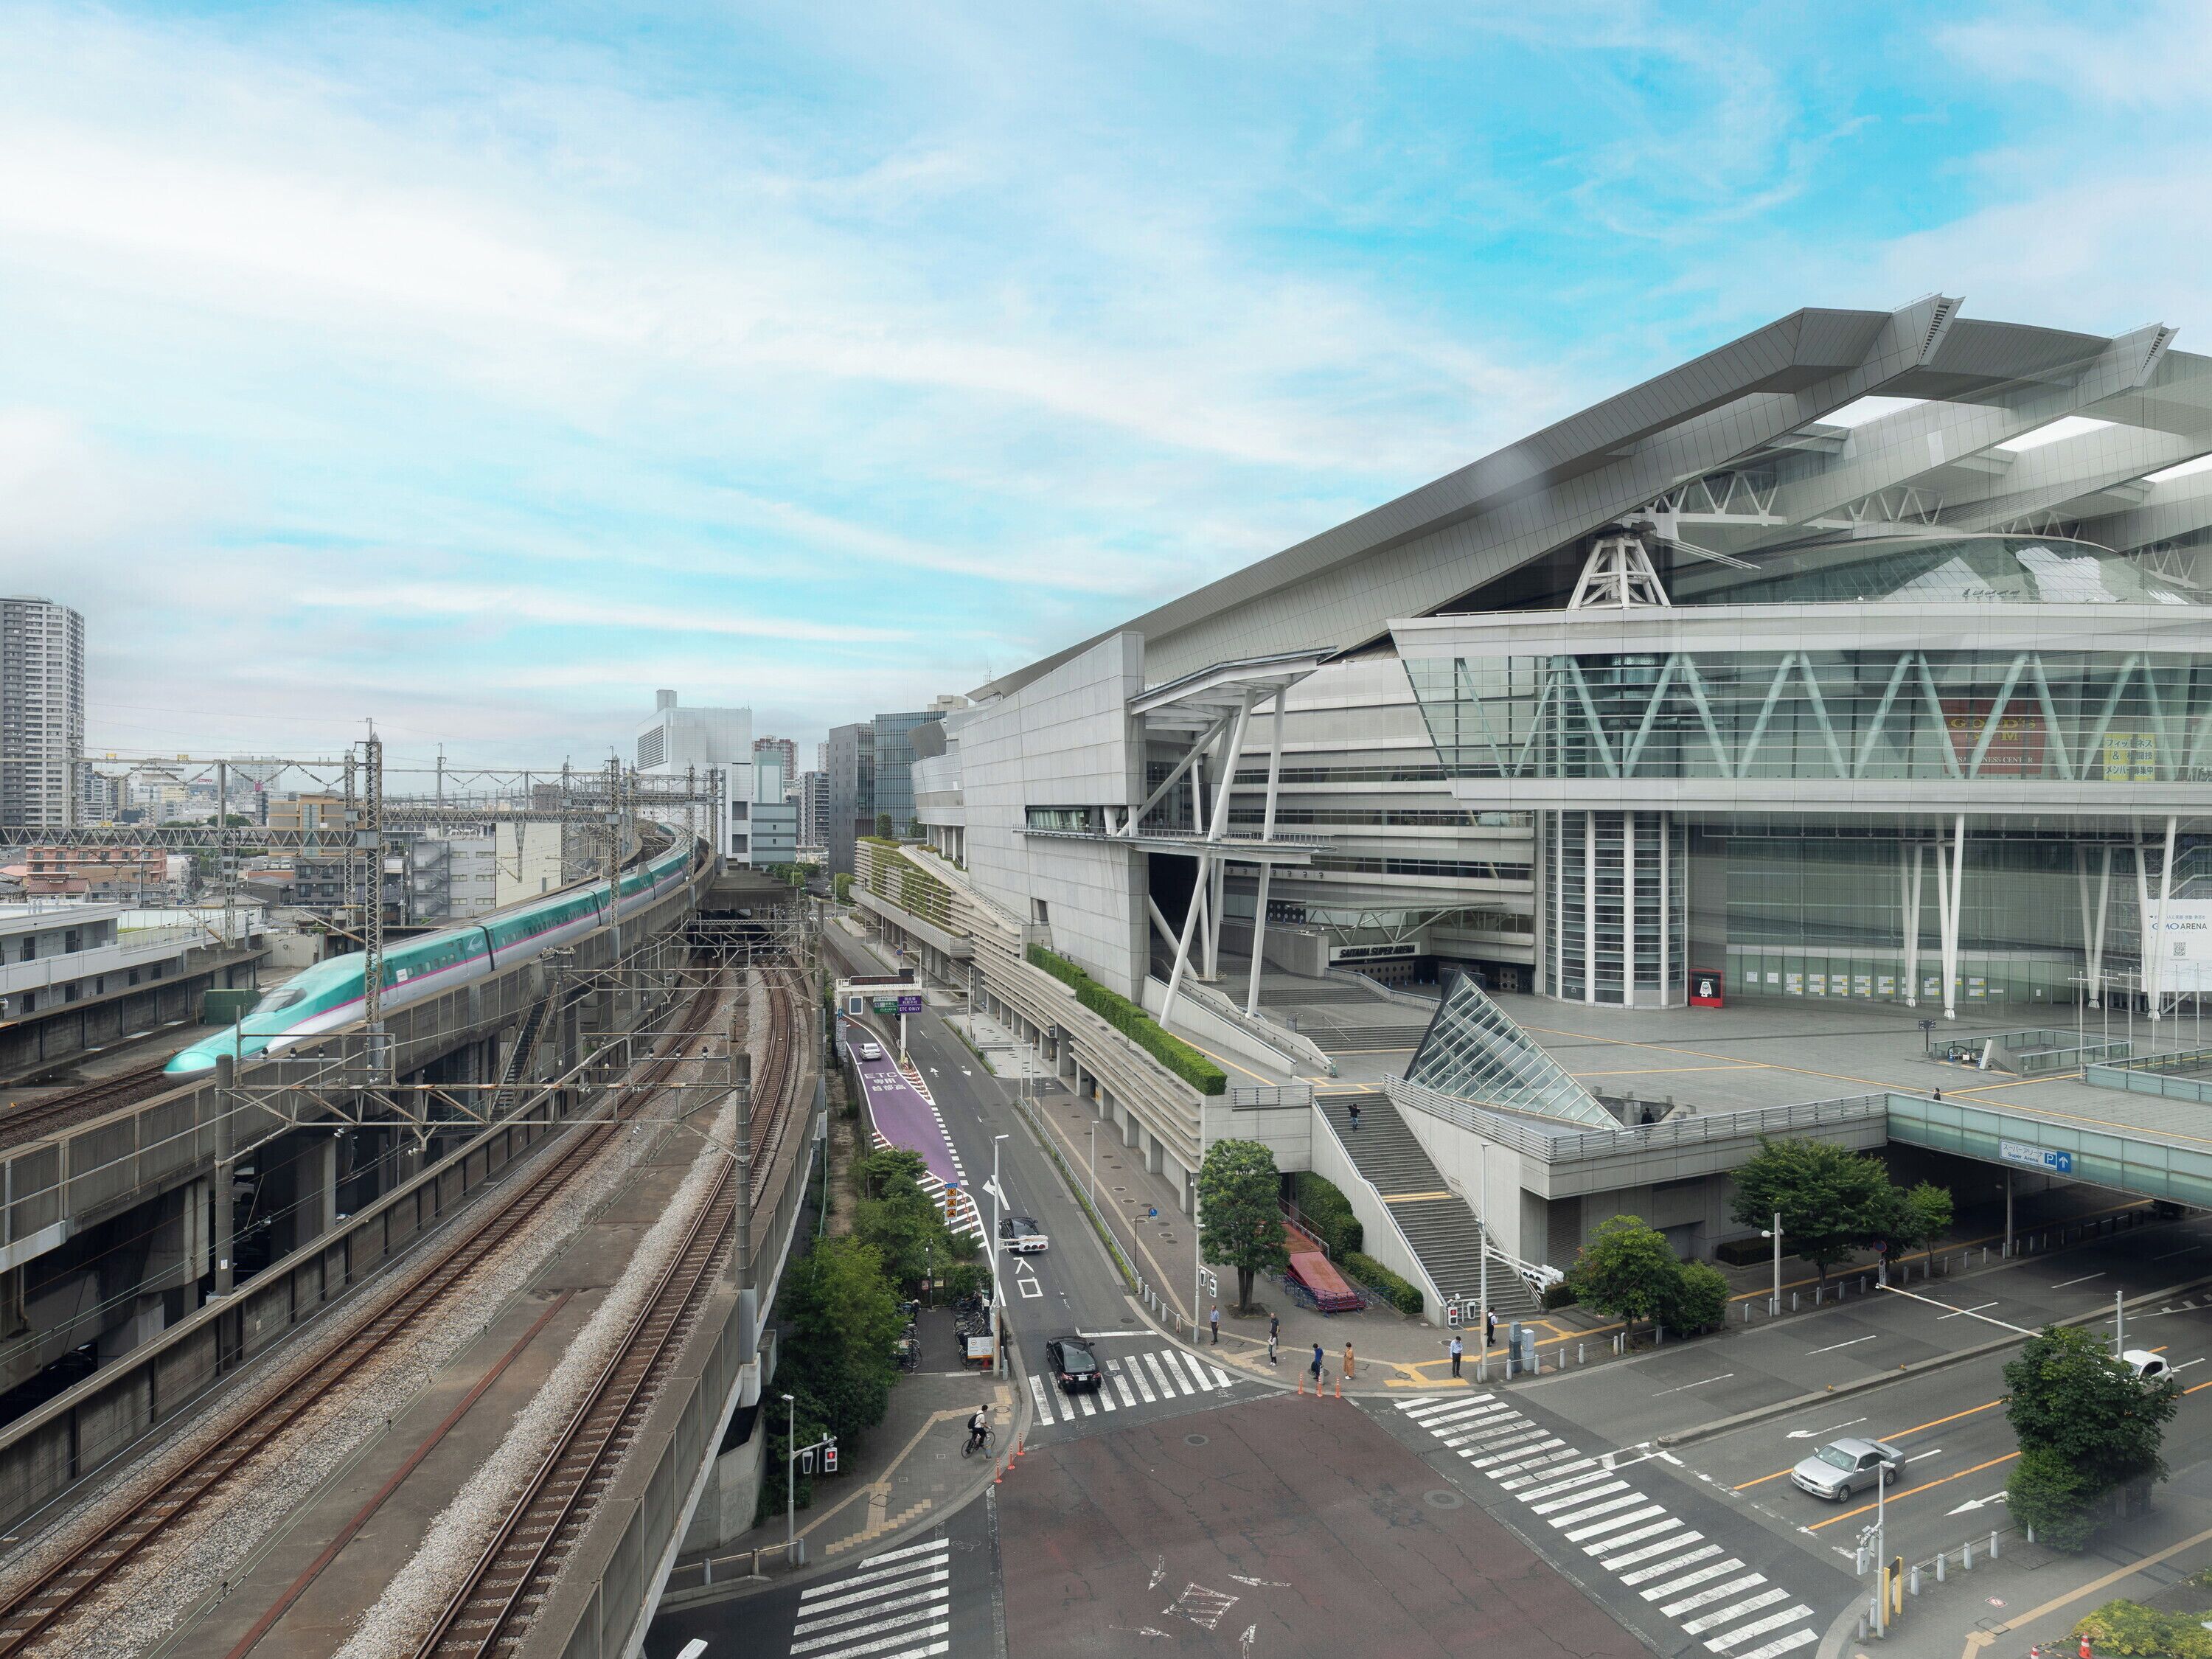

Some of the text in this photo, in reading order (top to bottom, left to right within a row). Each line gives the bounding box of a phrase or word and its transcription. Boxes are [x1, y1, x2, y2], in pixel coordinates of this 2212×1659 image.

[1950, 717, 2036, 728] GOD'S
[2107, 739, 2152, 748] フィッネス
[2112, 751, 2119, 760] &
[1340, 945, 1415, 958] SAITAMA SUPER ARENA
[2003, 1144, 2043, 1157] スーパーアリーナ
[2047, 1155, 2053, 1164] P
[1013, 1256, 1043, 1298] 入口
